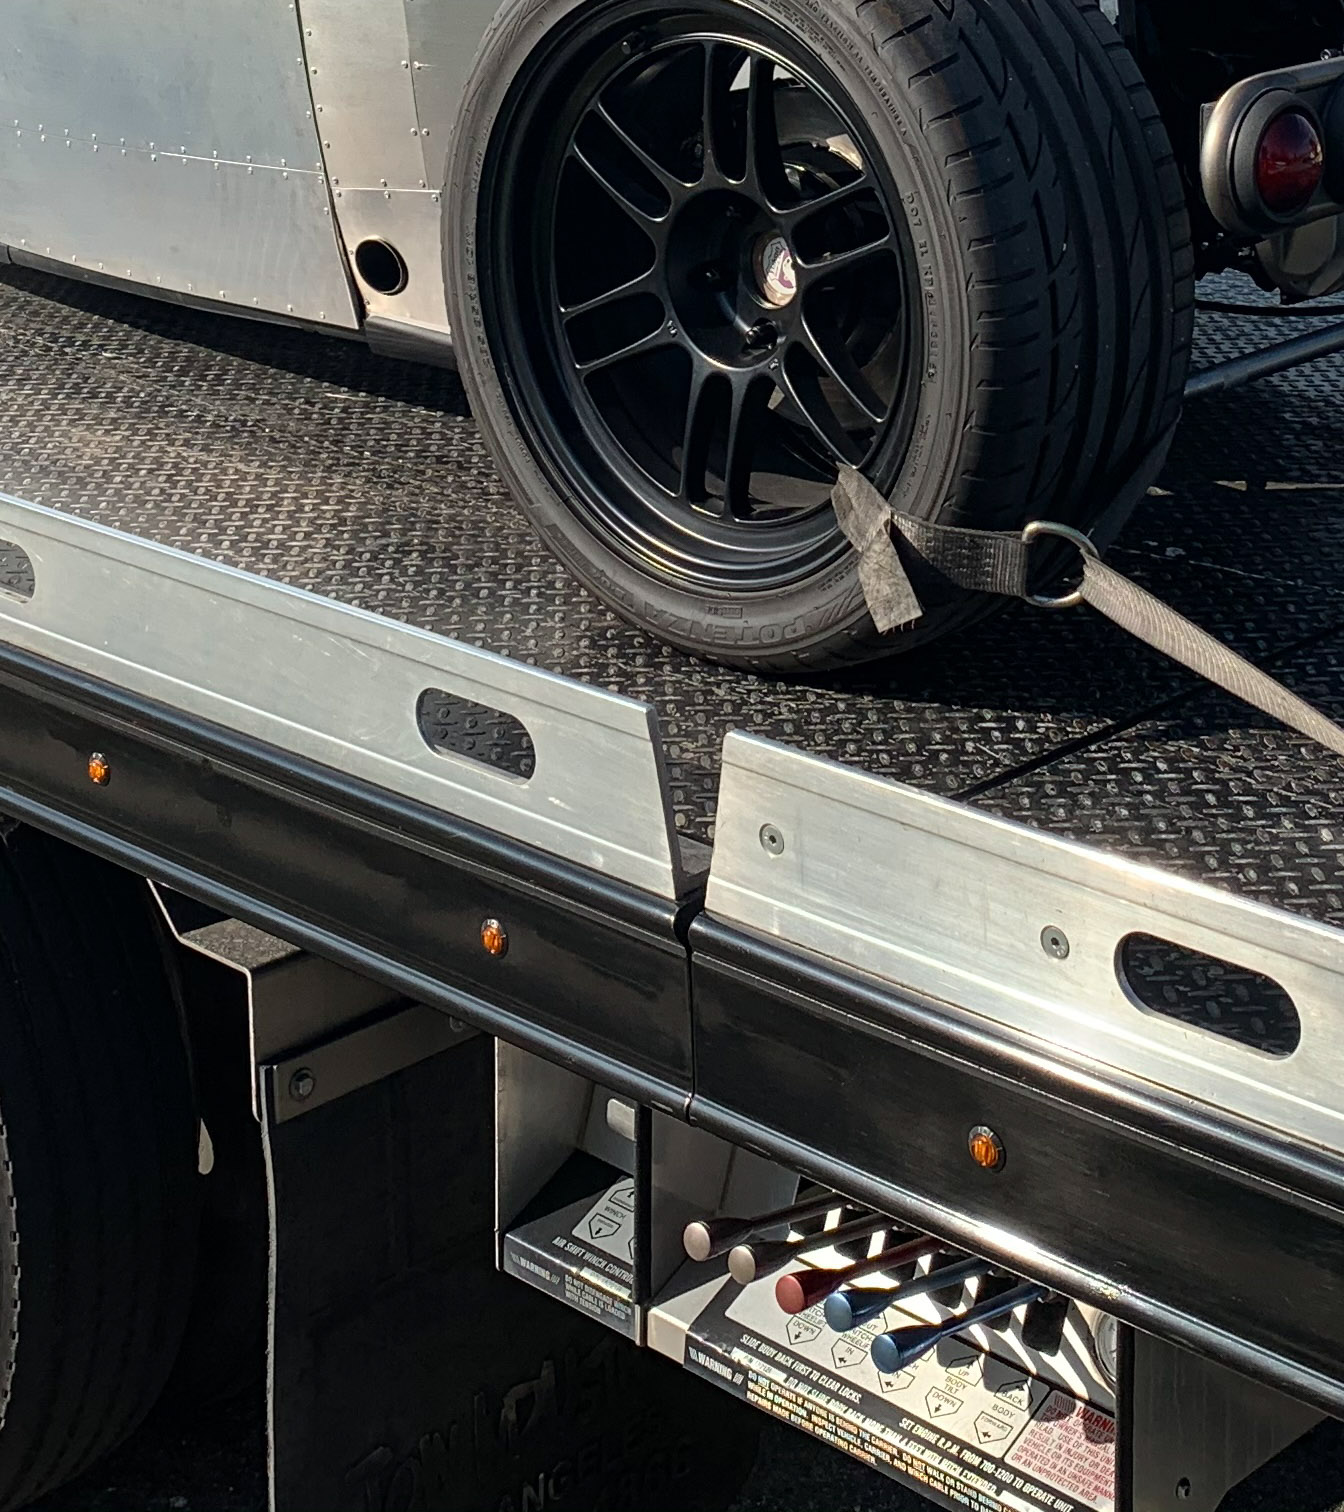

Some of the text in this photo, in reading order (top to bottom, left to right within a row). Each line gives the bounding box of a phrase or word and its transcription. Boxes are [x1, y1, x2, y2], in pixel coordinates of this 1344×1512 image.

[643, 601, 809, 669] POTENZA
[552, 1234, 566, 1249] AIR
[564, 1241, 585, 1258] SHIFT
[582, 1250, 607, 1270] WINCH
[519, 1256, 550, 1281] WARNING
[581, 1290, 597, 1305] CABLE
[792, 1318, 816, 1335] DOWN
[844, 1346, 855, 1356] IN
[697, 1350, 733, 1382] WARNING
[739, 1332, 761, 1350] SLIDE
[757, 1341, 778, 1359] BODY
[774, 1350, 795, 1368] BACK
[791, 1360, 812, 1377] FIRST
[809, 1369, 821, 1382] TO
[818, 1374, 841, 1392] CLEAR
[837, 1384, 863, 1404] LOCKS.
[958, 1368, 971, 1377] UP
[943, 1383, 958, 1395] TILT
[944, 1374, 967, 1390] BODY
[772, 1402, 790, 1420] MADE
[930, 1390, 956, 1408] DOWN
[991, 1402, 1015, 1419] BODY
[1000, 1391, 1025, 1406] BACK
[770, 1381, 796, 1403] OPERATE
[902, 1451, 911, 1464] DO
[926, 1464, 944, 1482] WALK
[945, 1474, 954, 1488] OR
[955, 1479, 977, 1500] STAND
[1027, 1428, 1056, 1447] RESULT
[1053, 1442, 1065, 1452] IN
[1062, 1446, 1089, 1465] INJURY
[1087, 1459, 1101, 1471] OR
[1056, 1432, 1073, 1445] USE
[1071, 1439, 1084, 1450] OF
[1082, 1445, 1101, 1459] THIS
[898, 1416, 1074, 1512] SET ENGINE R.P.M. FROM 700-1200 TO OPERATE UNIT
[1010, 1452, 1023, 1464] OR
[1020, 1457, 1033, 1469] AN
[1030, 1463, 1082, 1494] UNPROTECTED
[1015, 1444, 1051, 1467] OPERATED
[1048, 1461, 1059, 1471] IN
[1056, 1465, 1069, 1476] AN
[1066, 1470, 1095, 1490] UNSAFE
[1021, 1436, 1116, 1489] VEHICLE OR ITS EQUIPMENT
[893, 1457, 906, 1472] AND
[928, 1476, 948, 1495] CABLE
[970, 1498, 979, 1512] TO
